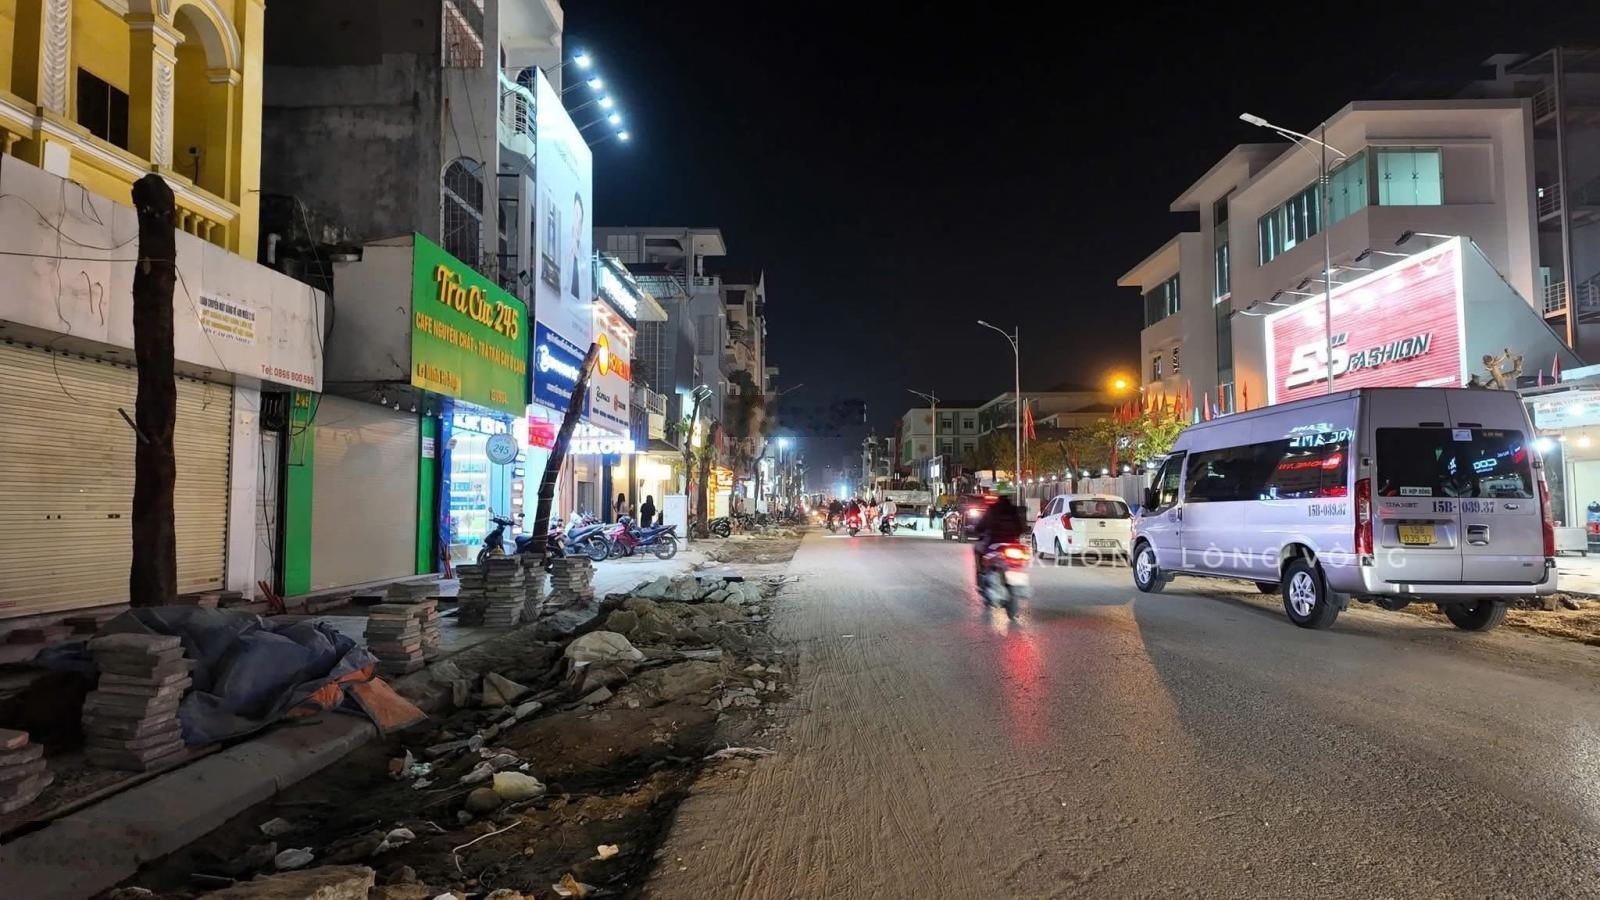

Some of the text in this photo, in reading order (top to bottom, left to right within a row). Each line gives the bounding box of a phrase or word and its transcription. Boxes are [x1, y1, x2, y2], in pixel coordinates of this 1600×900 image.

[436, 265, 468, 314] Trà
[493, 301, 519, 340] 245
[415, 312, 432, 332] CAFE
[1347, 332, 1432, 374] FASHION
[1462, 502, 1495, 513] 039.37
